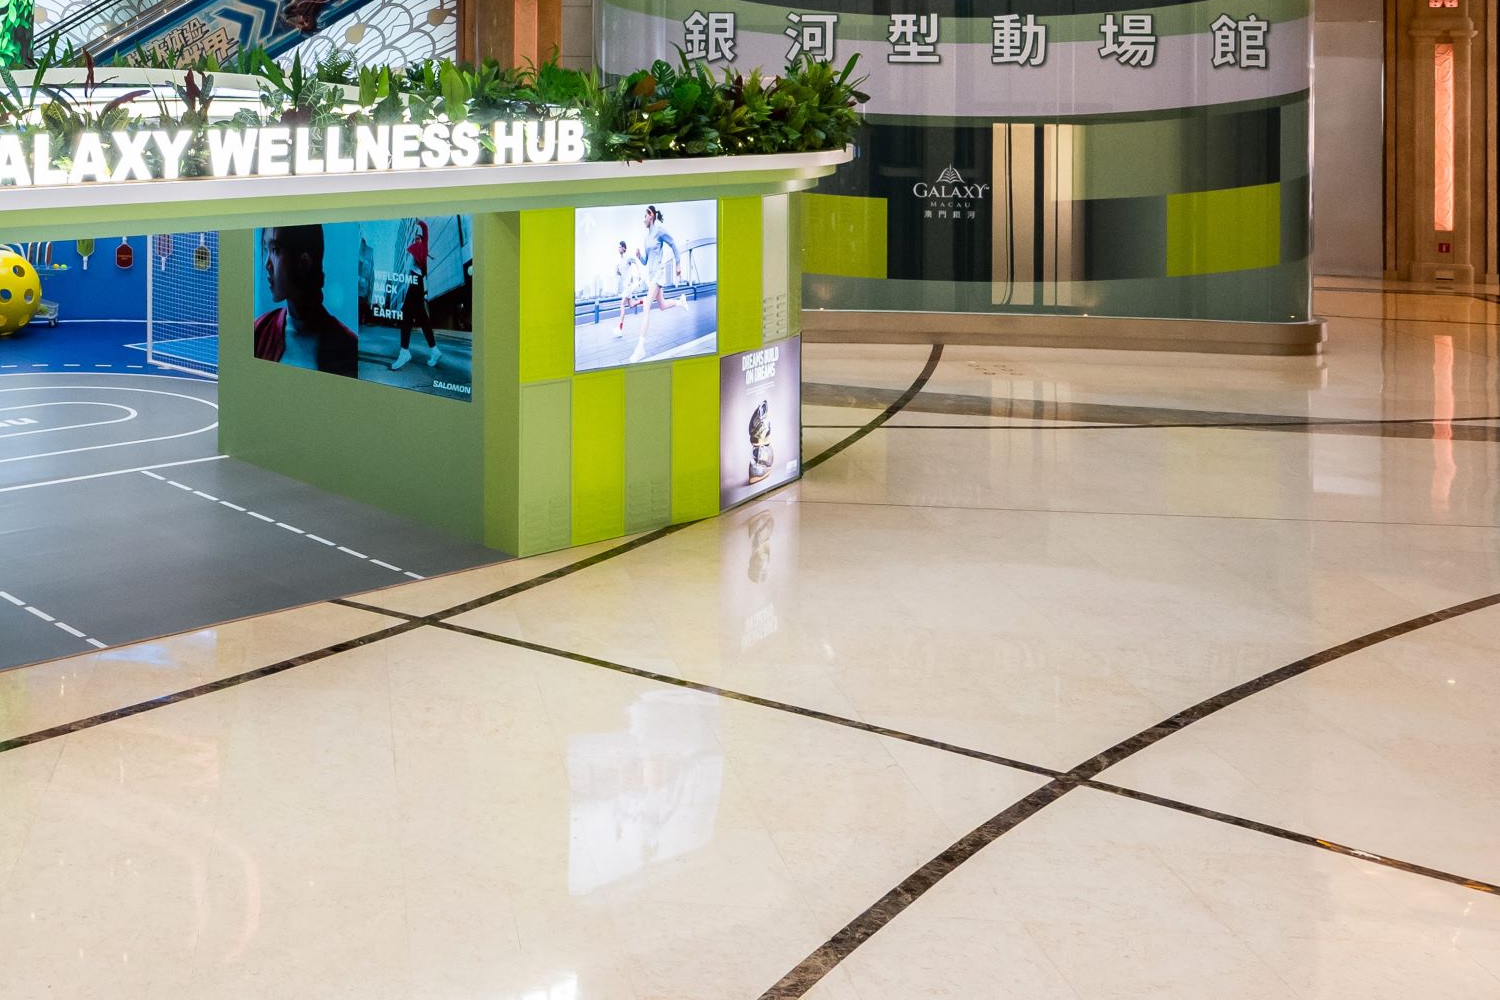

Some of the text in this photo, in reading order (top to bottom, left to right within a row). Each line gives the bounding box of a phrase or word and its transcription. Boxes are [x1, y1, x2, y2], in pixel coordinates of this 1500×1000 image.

[684, 10, 1271, 70] 銀河型動場館
[207, 120, 480, 177] WELLNESS
[494, 119, 586, 165] HUB
[374, 269, 419, 285] WELCOME
[373, 307, 404, 320] EARTH
[432, 380, 471, 394] SALOMON
